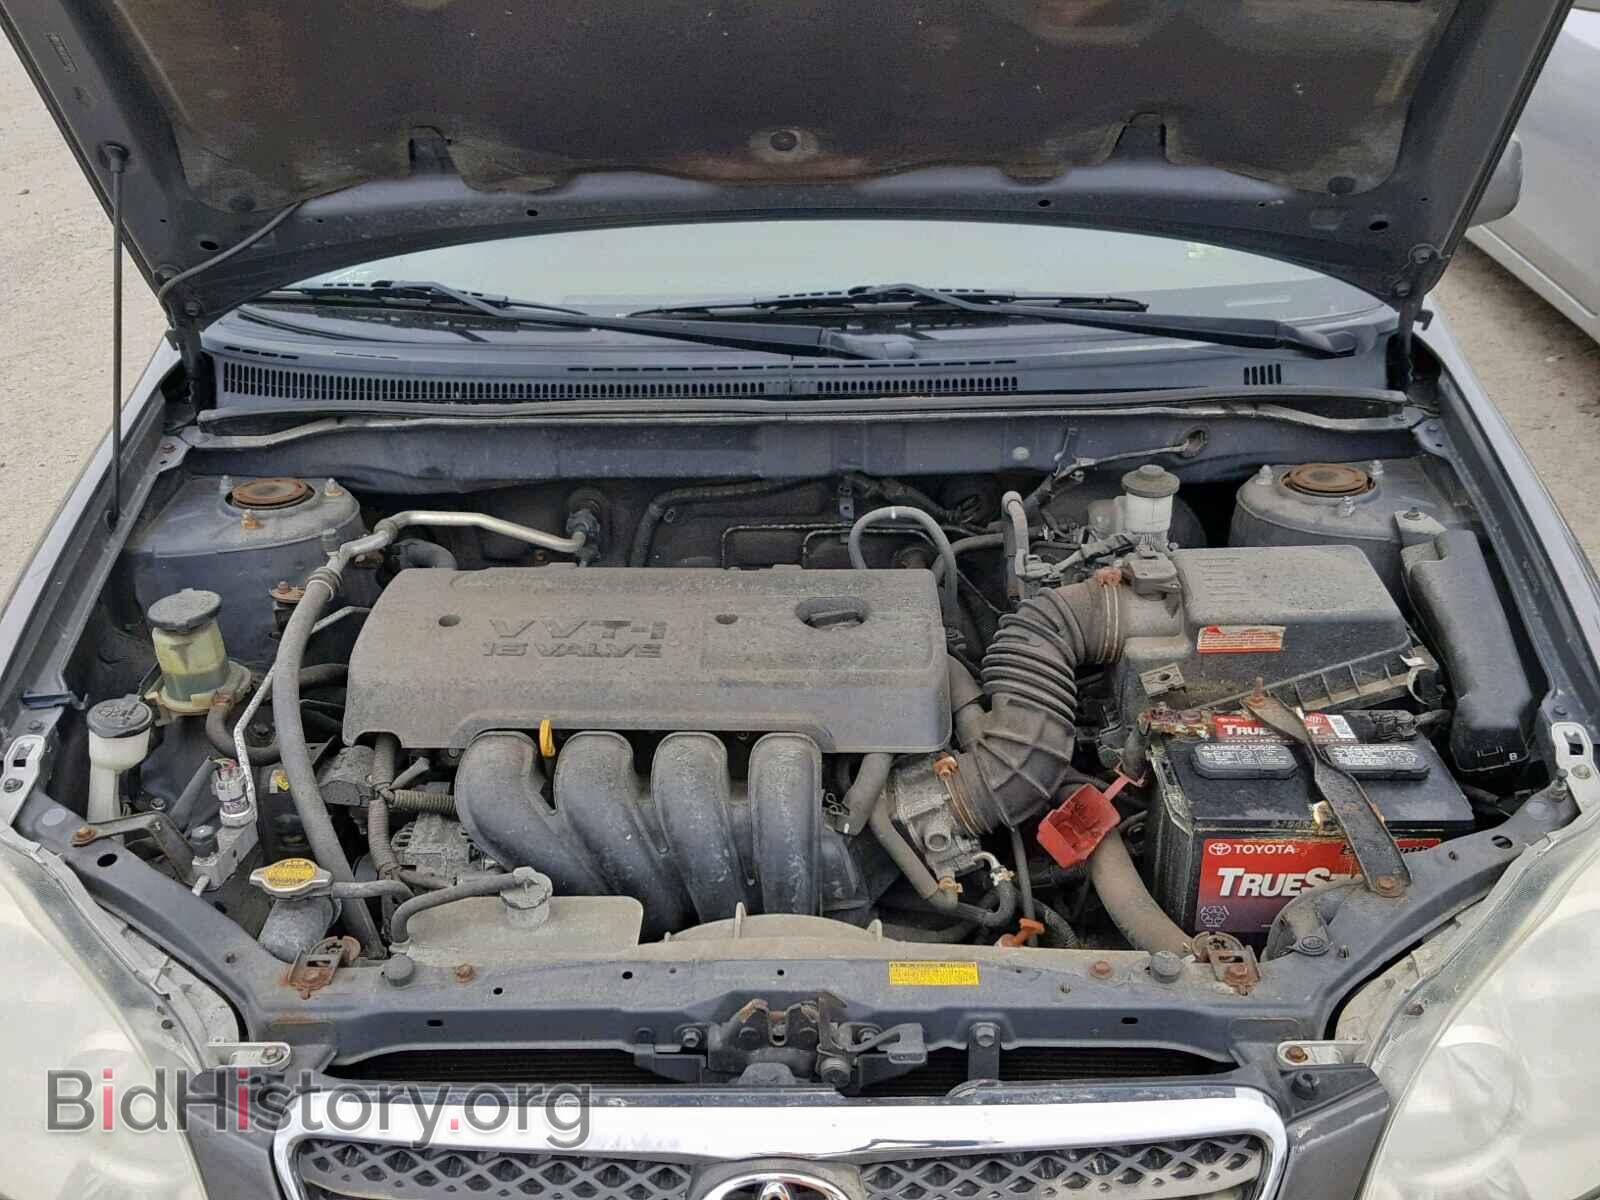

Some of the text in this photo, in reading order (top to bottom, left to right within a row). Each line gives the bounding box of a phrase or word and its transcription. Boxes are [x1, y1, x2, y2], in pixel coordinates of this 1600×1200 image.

[483, 641, 663, 659] 16 VALVE
[1234, 844, 1296, 855] TOYOTA
